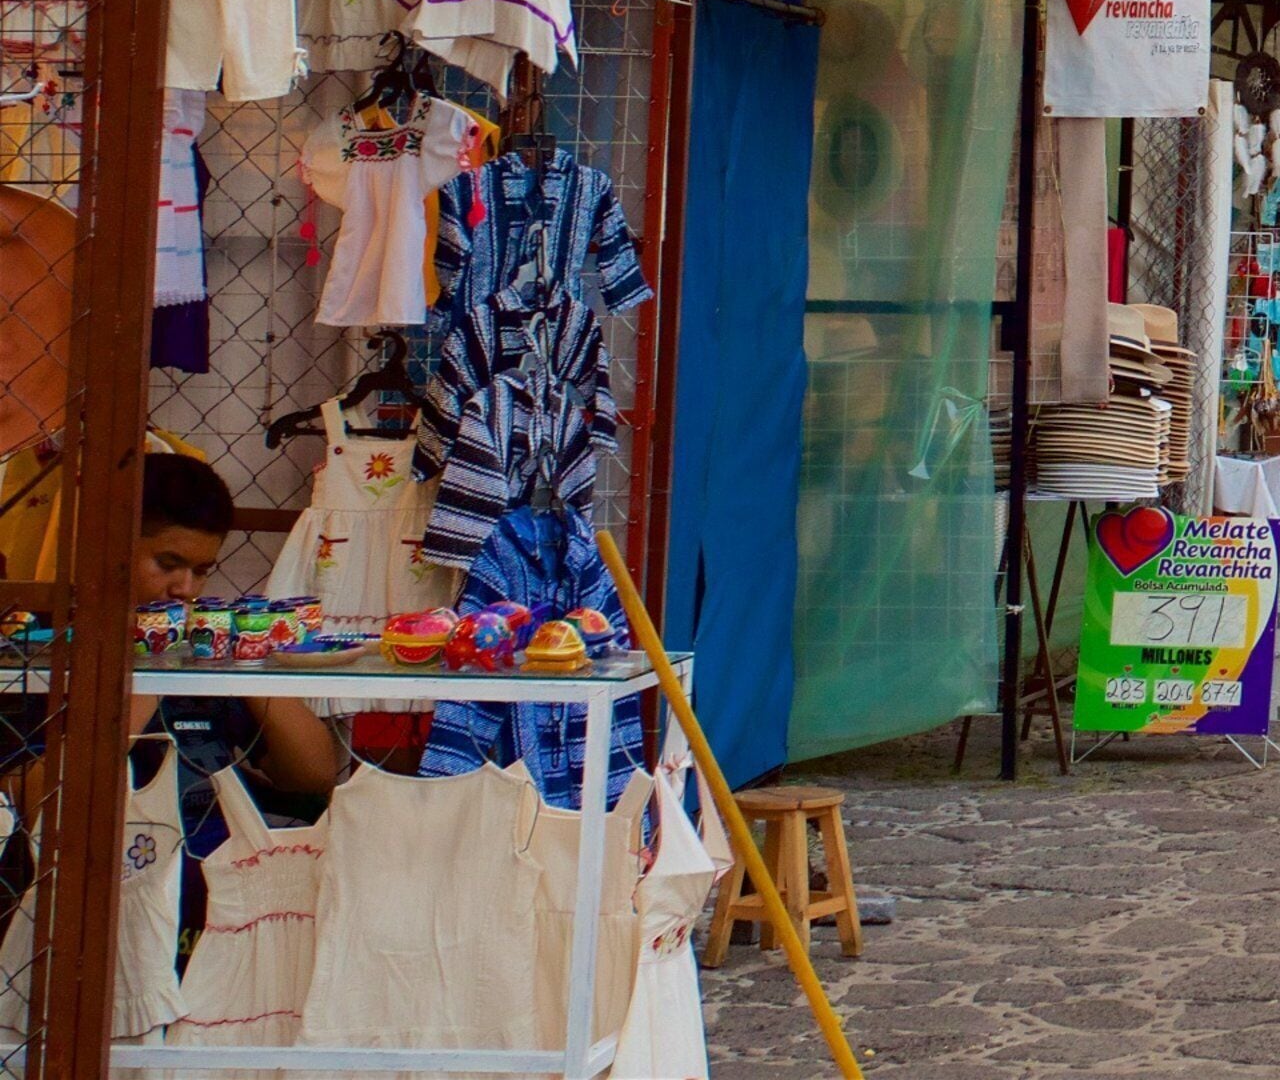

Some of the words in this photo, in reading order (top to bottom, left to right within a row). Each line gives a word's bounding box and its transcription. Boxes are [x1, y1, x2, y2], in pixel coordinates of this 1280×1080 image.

[1183, 520, 1269, 539] Melate
[1172, 540, 1271, 560] Revancha
[1157, 559, 1272, 579] Revanchita
[1134, 580, 1164, 591] Bolsa
[1166, 581, 1229, 592] Acumulada
[1147, 595, 1224, 643] 391
[1141, 647, 1213, 666] MILLONES
